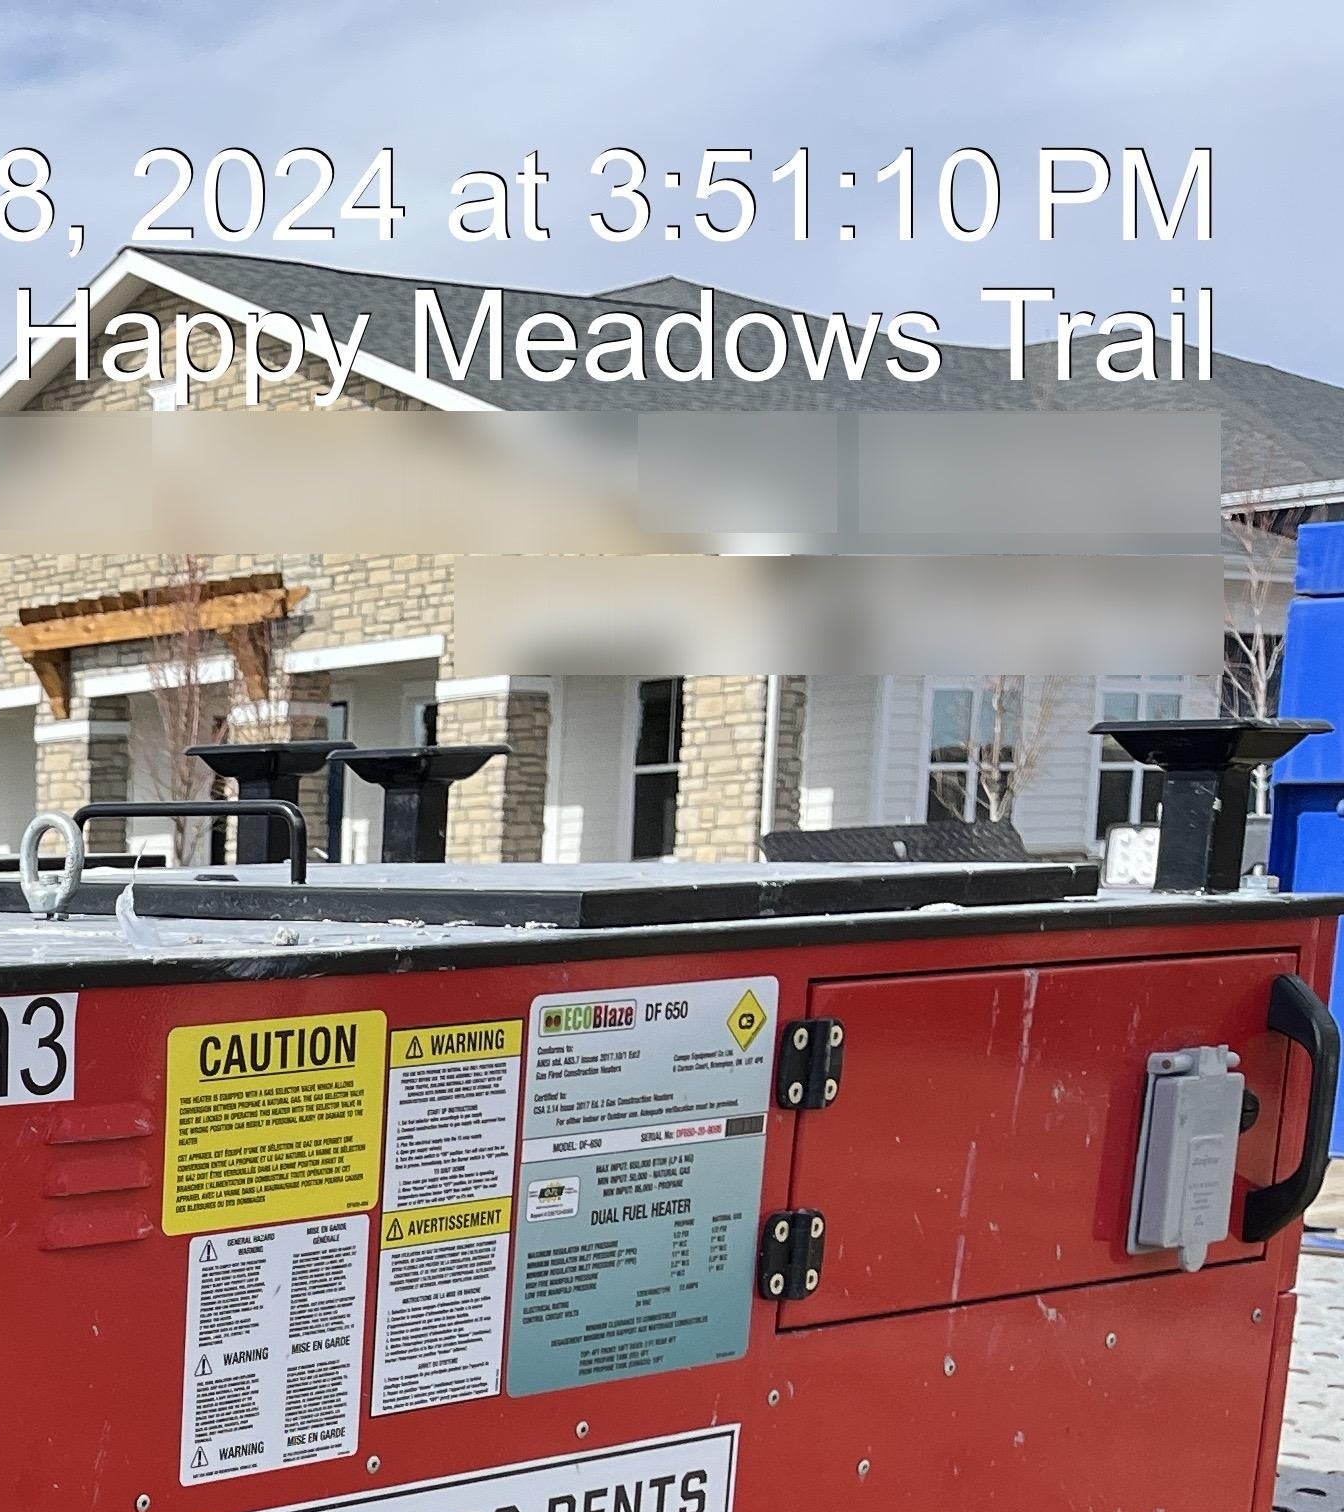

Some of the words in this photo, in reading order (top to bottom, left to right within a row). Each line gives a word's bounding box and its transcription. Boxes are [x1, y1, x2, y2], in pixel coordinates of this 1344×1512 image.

[664, 1000, 688, 1020] 650
[198, 1023, 358, 1078] CAUTION
[430, 1028, 505, 1056] WARNING
[407, 1208, 502, 1236] AVERTISSEMENT
[590, 1207, 619, 1227] DUAL
[622, 1202, 649, 1222] FUEL
[651, 1196, 691, 1217] HEATER
[291, 1339, 311, 1355] MISE
[312, 1338, 324, 1351] EN
[324, 1335, 351, 1351] GARDE
[223, 1346, 269, 1367] WARNING
[286, 1432, 307, 1447] MISE
[308, 1431, 319, 1444] EN
[319, 1426, 346, 1442] GARDE
[219, 1440, 265, 1461] WARNING
